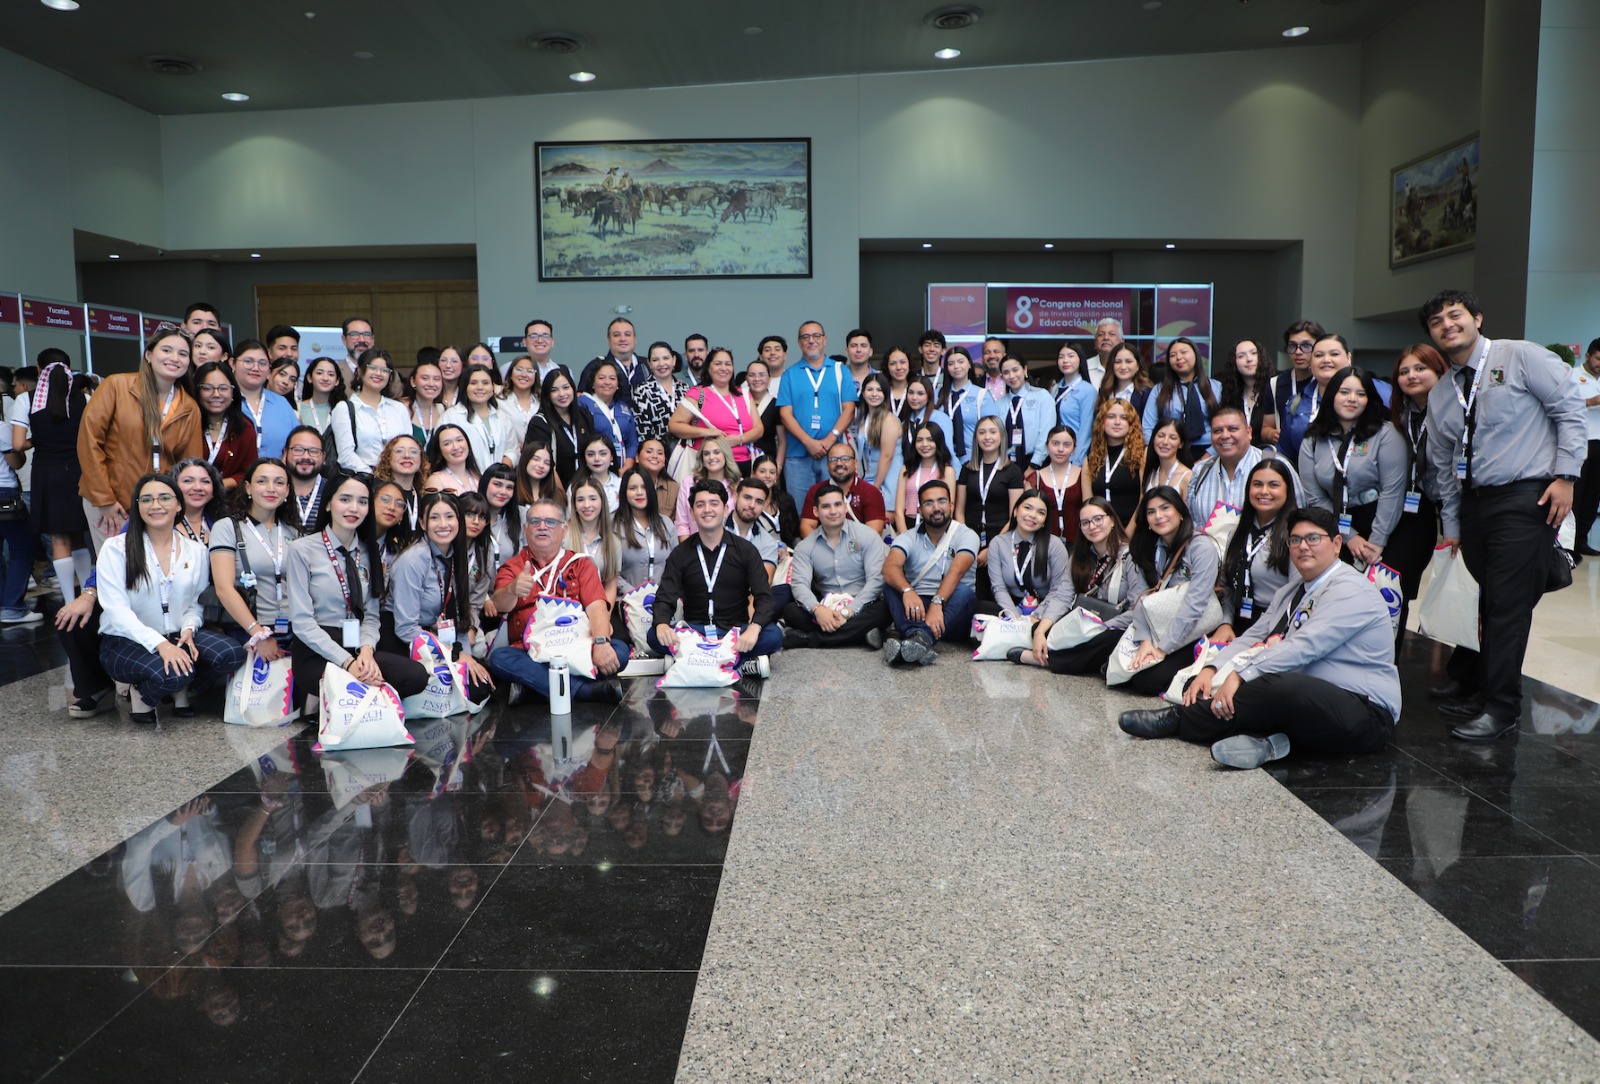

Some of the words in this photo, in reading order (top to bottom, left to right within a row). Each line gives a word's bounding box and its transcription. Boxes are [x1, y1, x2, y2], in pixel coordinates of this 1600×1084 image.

[1039, 300, 1082, 310] Congreso
[1084, 300, 1123, 309] Nacional
[1102, 310, 1123, 318] sobre
[1039, 317, 1087, 328] Educación
